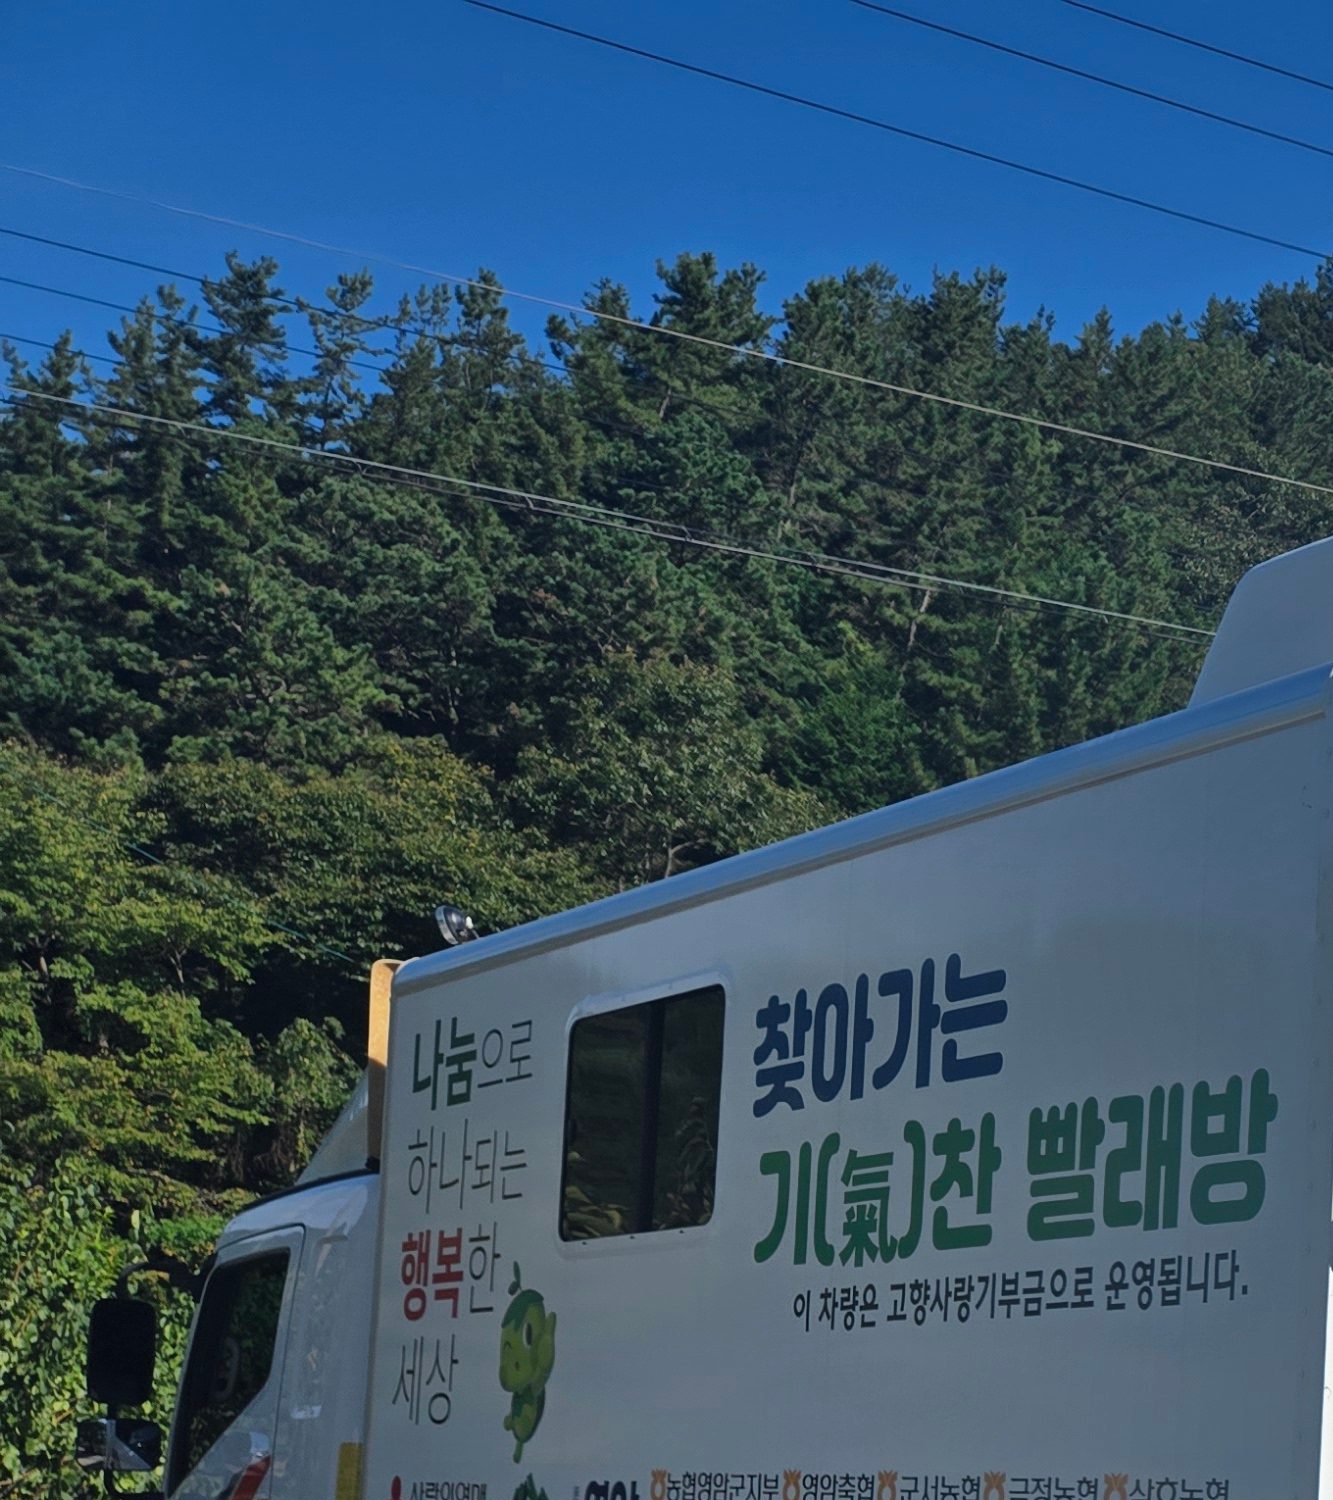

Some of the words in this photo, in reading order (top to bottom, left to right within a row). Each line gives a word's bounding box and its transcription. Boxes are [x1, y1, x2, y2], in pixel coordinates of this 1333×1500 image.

[412, 1017, 532, 1111] 나눔으로
[753, 953, 1008, 1118] 찾아가는
[408, 1119, 527, 1214] 하나되는
[753, 1112, 1002, 1267] 기(氣)찬
[1027, 1068, 1278, 1241] 빨래방
[401, 1222, 500, 1322] 행복한
[794, 1290, 811, 1332] 이
[819, 1284, 878, 1331] 차량은
[887, 1267, 1094, 1326] 고향사랑기부금으로
[1105, 1250, 1248, 1311] 운영됩니다.
[392, 1334, 459, 1425] 세상
